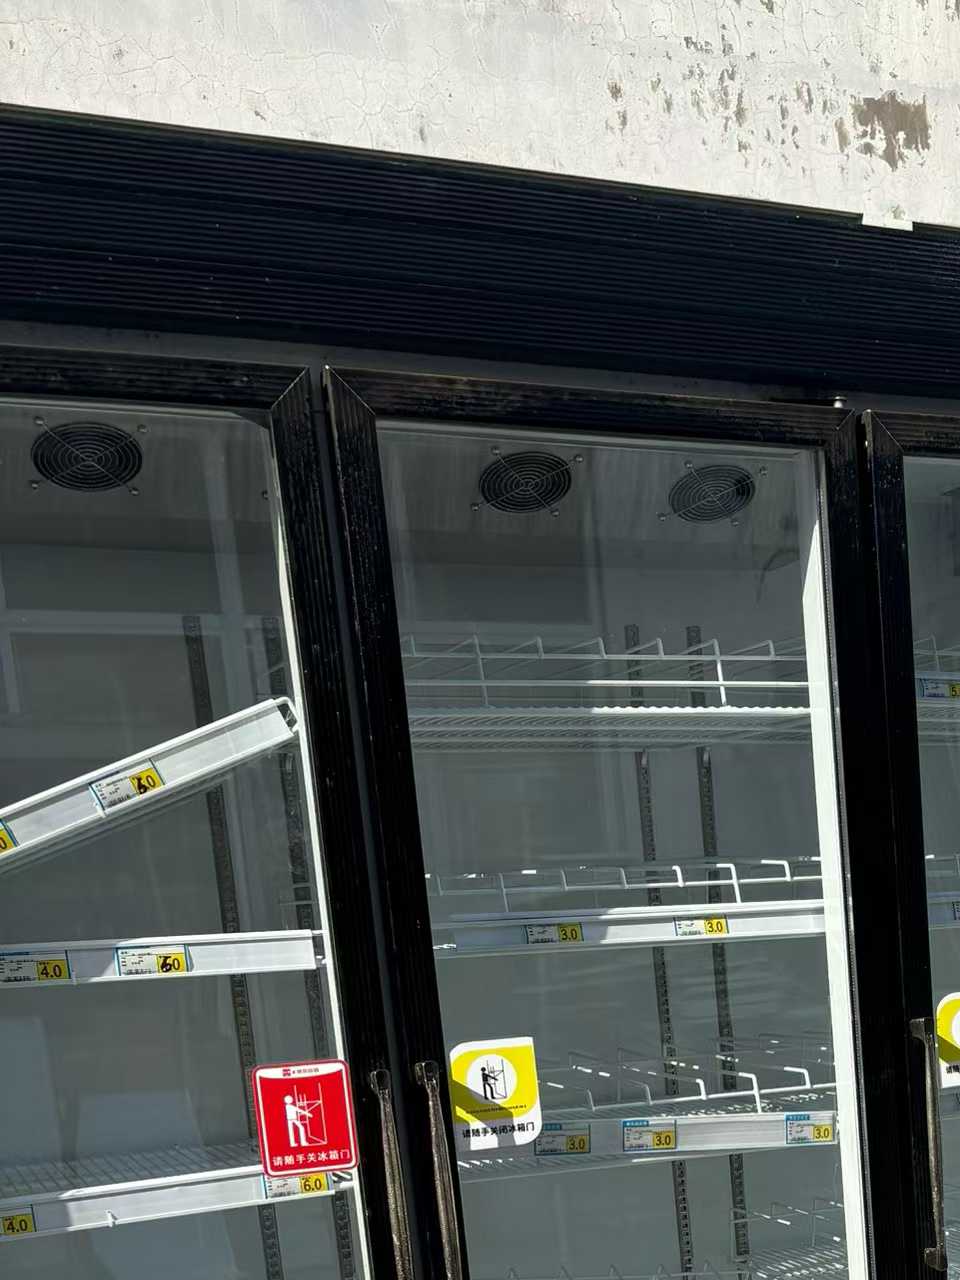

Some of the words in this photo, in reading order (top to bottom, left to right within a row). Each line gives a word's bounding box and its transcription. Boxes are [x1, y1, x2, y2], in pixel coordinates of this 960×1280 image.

[708, 921, 723, 933] 3.0
[561, 928, 578, 940] 3.0
[40, 964, 62, 978] 4.0
[462, 1122, 535, 1138] 请随手关闭冰箱门
[815, 1128, 830, 1139] 3.0
[569, 1139, 585, 1150] 3.0
[656, 1135, 671, 1146] 3.0
[273, 1150, 350, 1167] 请随手关冰箱门
[303, 1179, 321, 1191] 6.0
[6, 1219, 28, 1232] 4.0
